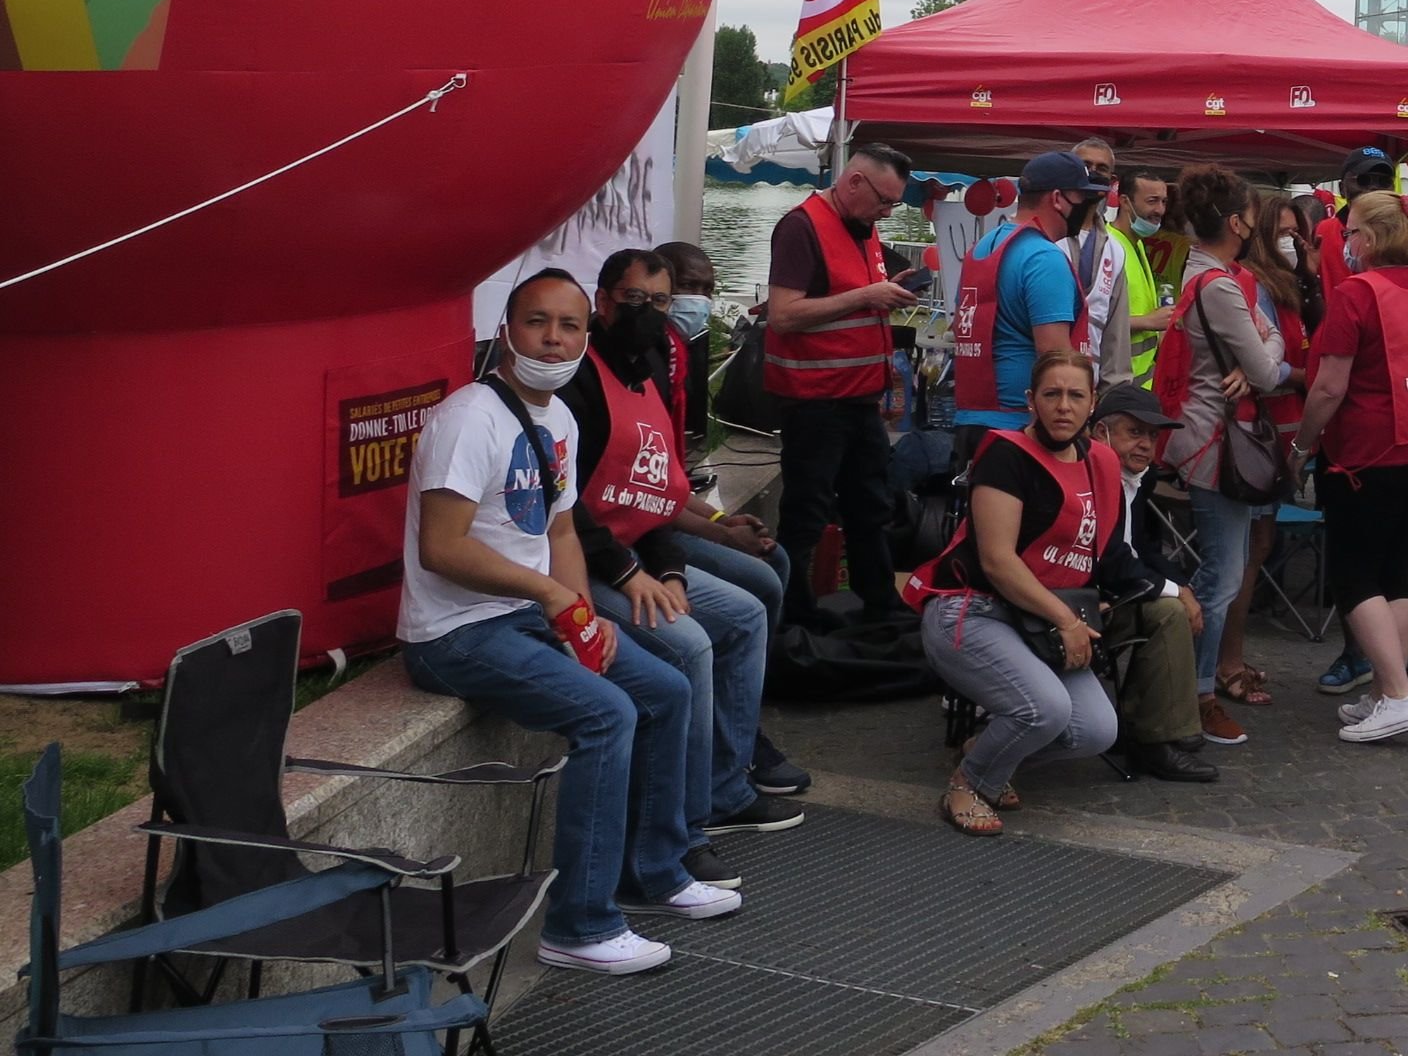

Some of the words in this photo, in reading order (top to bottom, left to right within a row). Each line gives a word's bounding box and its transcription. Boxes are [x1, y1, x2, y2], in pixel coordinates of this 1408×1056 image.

[972, 90, 992, 102] cgt
[1205, 97, 1225, 110] cgt
[350, 436, 407, 485] VOTE
[634, 449, 669, 484] cgt
[602, 483, 616, 502] UL
[618, 488, 633, 506] du
[1079, 518, 1097, 546] cg
[1043, 544, 1059, 564] UL
